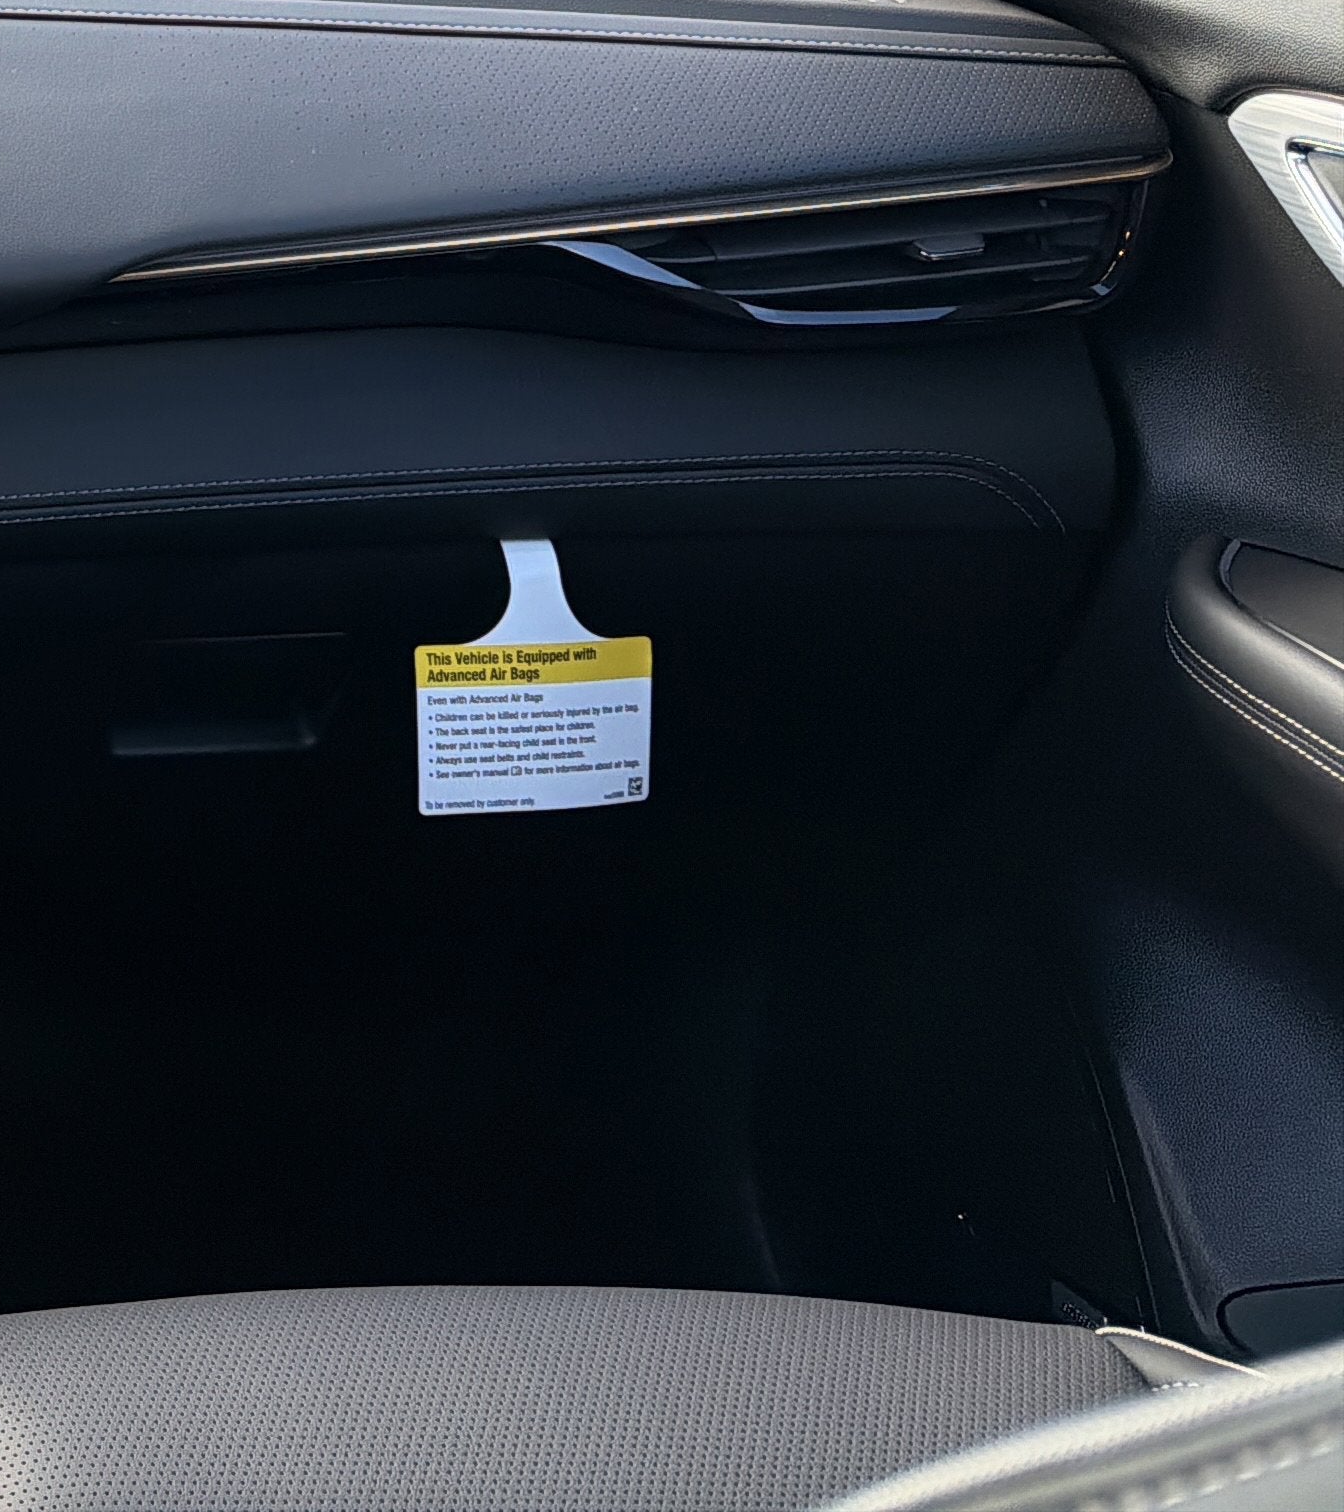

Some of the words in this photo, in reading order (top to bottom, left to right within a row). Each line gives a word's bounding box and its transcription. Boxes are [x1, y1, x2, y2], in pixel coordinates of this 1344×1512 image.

[426, 652, 452, 666] This
[455, 650, 499, 665] Vehicle
[502, 650, 513, 664] is
[517, 648, 570, 666] Equipped
[573, 647, 597, 661] with
[427, 668, 486, 683] Advanced
[490, 667, 508, 681] Air
[510, 666, 540, 683] Bags
[427, 695, 448, 706] Even
[450, 694, 468, 704] with
[469, 693, 509, 704] Advanced
[511, 693, 522, 703] Air
[524, 693, 544, 704] Bags
[435, 713, 468, 723] Children
[470, 713, 484, 722] can
[486, 712, 496, 721] be
[498, 711, 519, 720] killed
[602, 706, 613, 715] the
[436, 727, 449, 736] The
[451, 727, 469, 736] back
[471, 727, 488, 736] seat
[489, 726, 496, 735] is
[497, 725, 509, 734] the
[535, 724, 554, 734] place
[556, 722, 565, 731] for
[436, 742, 457, 751] Never
[459, 741, 472, 752] put
[474, 742, 479, 750] a
[523, 738, 540, 747] child
[542, 738, 557, 746] seat
[567, 736, 578, 745] the
[436, 755, 463, 766] Always
[464, 756, 478, 764] use
[479, 755, 496, 764] seat
[497, 753, 515, 763] belts
[517, 752, 531, 762] and
[533, 752, 550, 761] child
[436, 769, 450, 779] See
[525, 767, 534, 776] for
[536, 767, 554, 775] more
[425, 800, 434, 810] To
[435, 800, 444, 809] be
[445, 800, 476, 809] removed
[477, 799, 485, 809] by
[487, 798, 519, 807] customer
